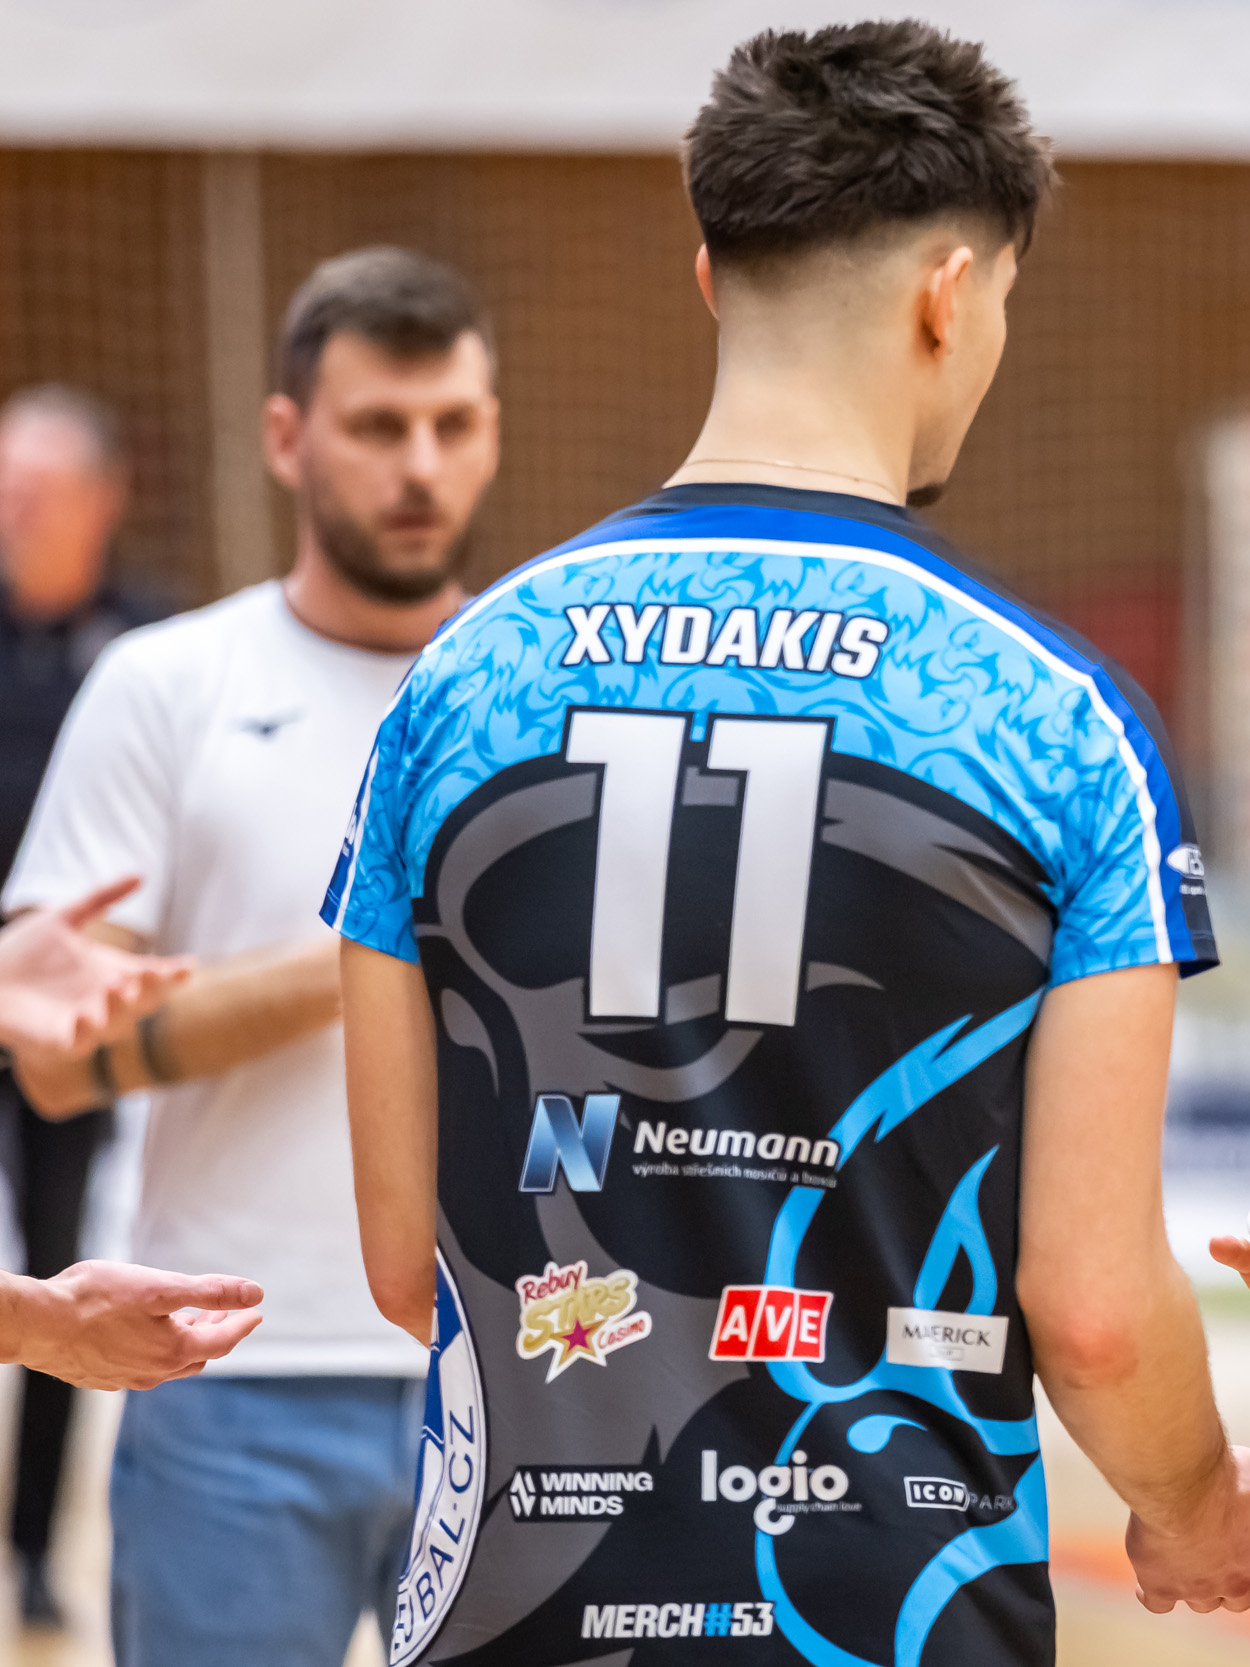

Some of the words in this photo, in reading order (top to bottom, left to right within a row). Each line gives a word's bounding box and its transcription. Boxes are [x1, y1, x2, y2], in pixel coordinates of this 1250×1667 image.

[562, 605, 889, 679] XYDAKIS
[566, 711, 830, 1027] 11
[633, 1121, 839, 1167] Neumann
[632, 1162, 680, 1178] výroba
[522, 1266, 582, 1304] Rebuy
[523, 1277, 631, 1353] STARS
[720, 1305, 820, 1344] AVE
[598, 1319, 646, 1350] Casino
[540, 1471, 653, 1492] WINNING
[701, 1449, 849, 1536] logio
[913, 1483, 965, 1504] ICON
[968, 1491, 1015, 1512] PARK
[540, 1495, 624, 1516] MINDS
[581, 1602, 774, 1639] MERCH#53
